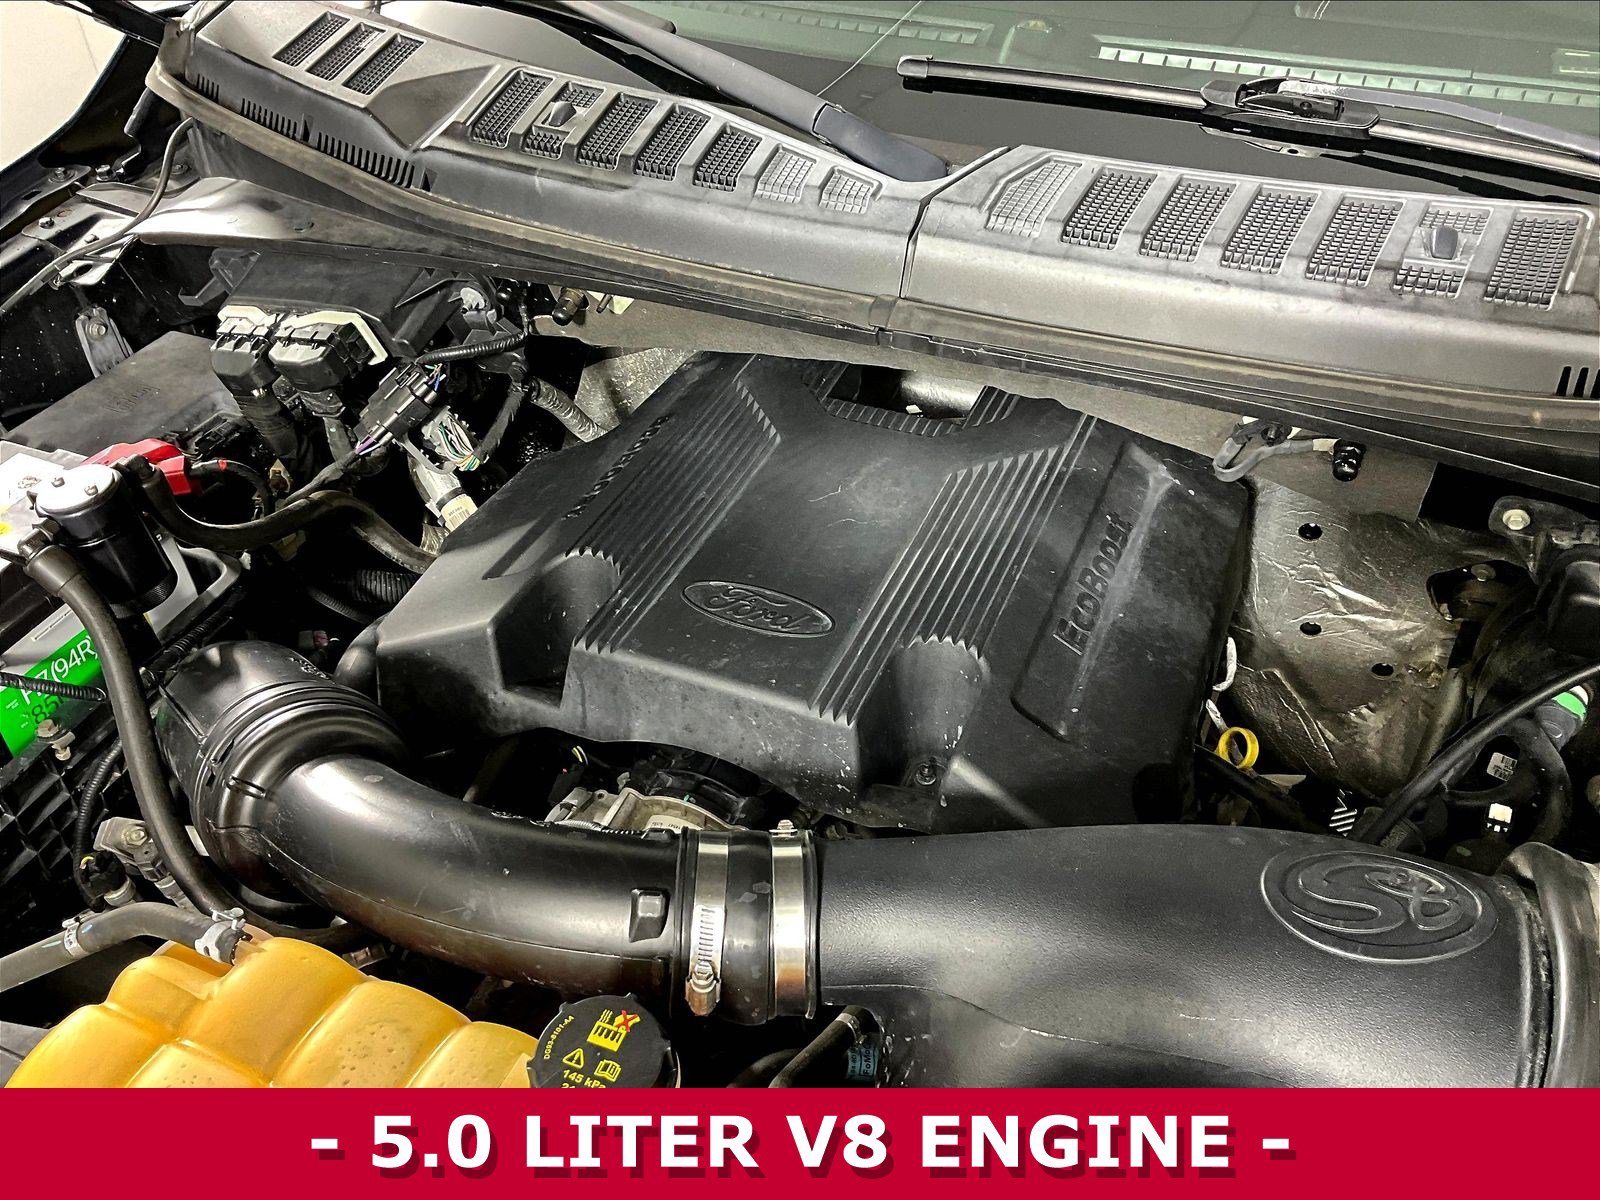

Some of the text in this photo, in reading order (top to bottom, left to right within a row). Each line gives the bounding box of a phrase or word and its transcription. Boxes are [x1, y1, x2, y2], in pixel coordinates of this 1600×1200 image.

[1052, 511, 1135, 656] EcoBoost
[700, 587, 812, 631] Ford
[562, 1069, 584, 1084] 145
